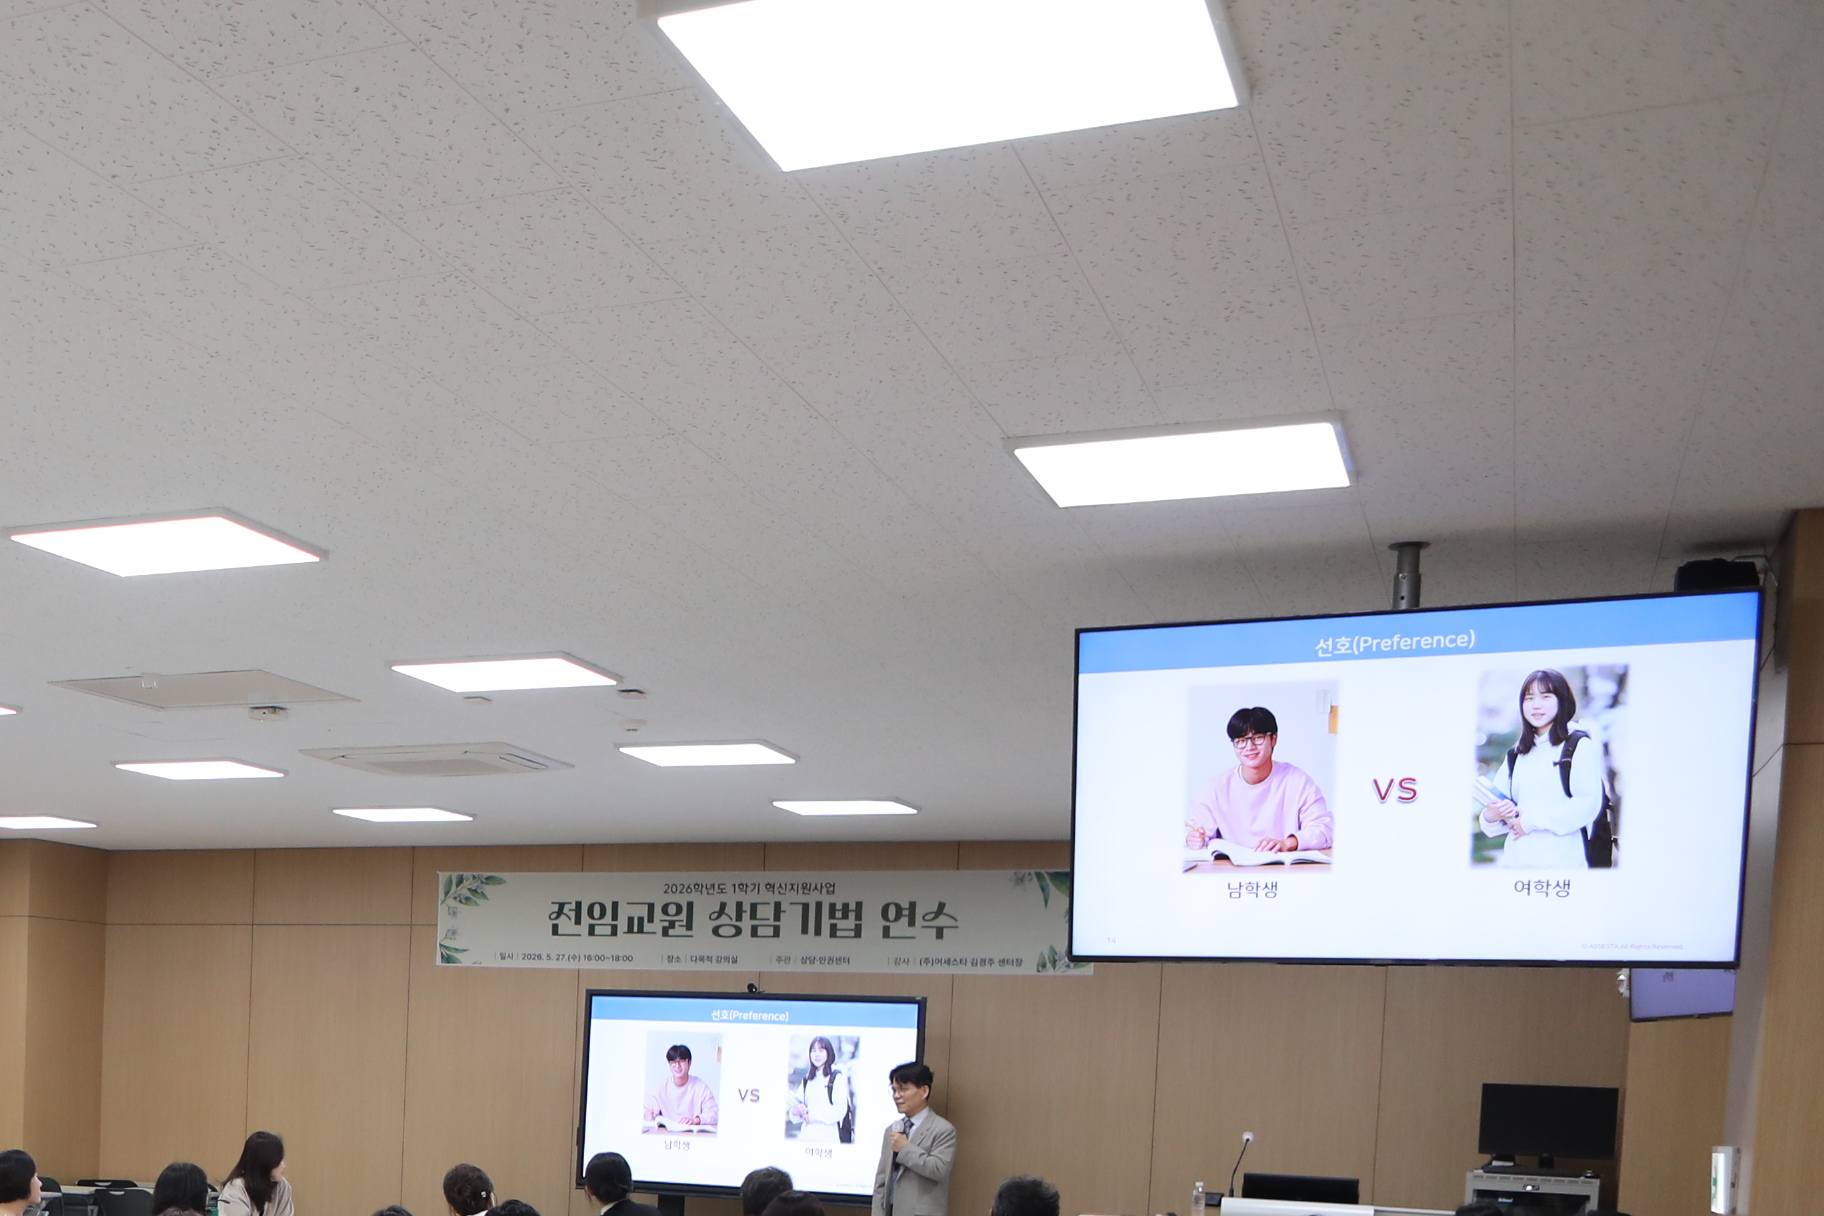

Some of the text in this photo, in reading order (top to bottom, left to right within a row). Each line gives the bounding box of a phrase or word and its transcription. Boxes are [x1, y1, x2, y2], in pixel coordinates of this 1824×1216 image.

[1314, 629, 1477, 659] 선호(Preference)
[1373, 776, 1419, 804] VS
[663, 881, 836, 896] 2026학년도 1학기 혁신지원사업
[1226, 879, 1280, 900] 남학생
[1513, 878, 1572, 900] 여학생
[547, 899, 960, 941] 전임교원 상담기법 연수
[711, 1009, 789, 1023] 선호(Preference)
[738, 1087, 761, 1104] VS
